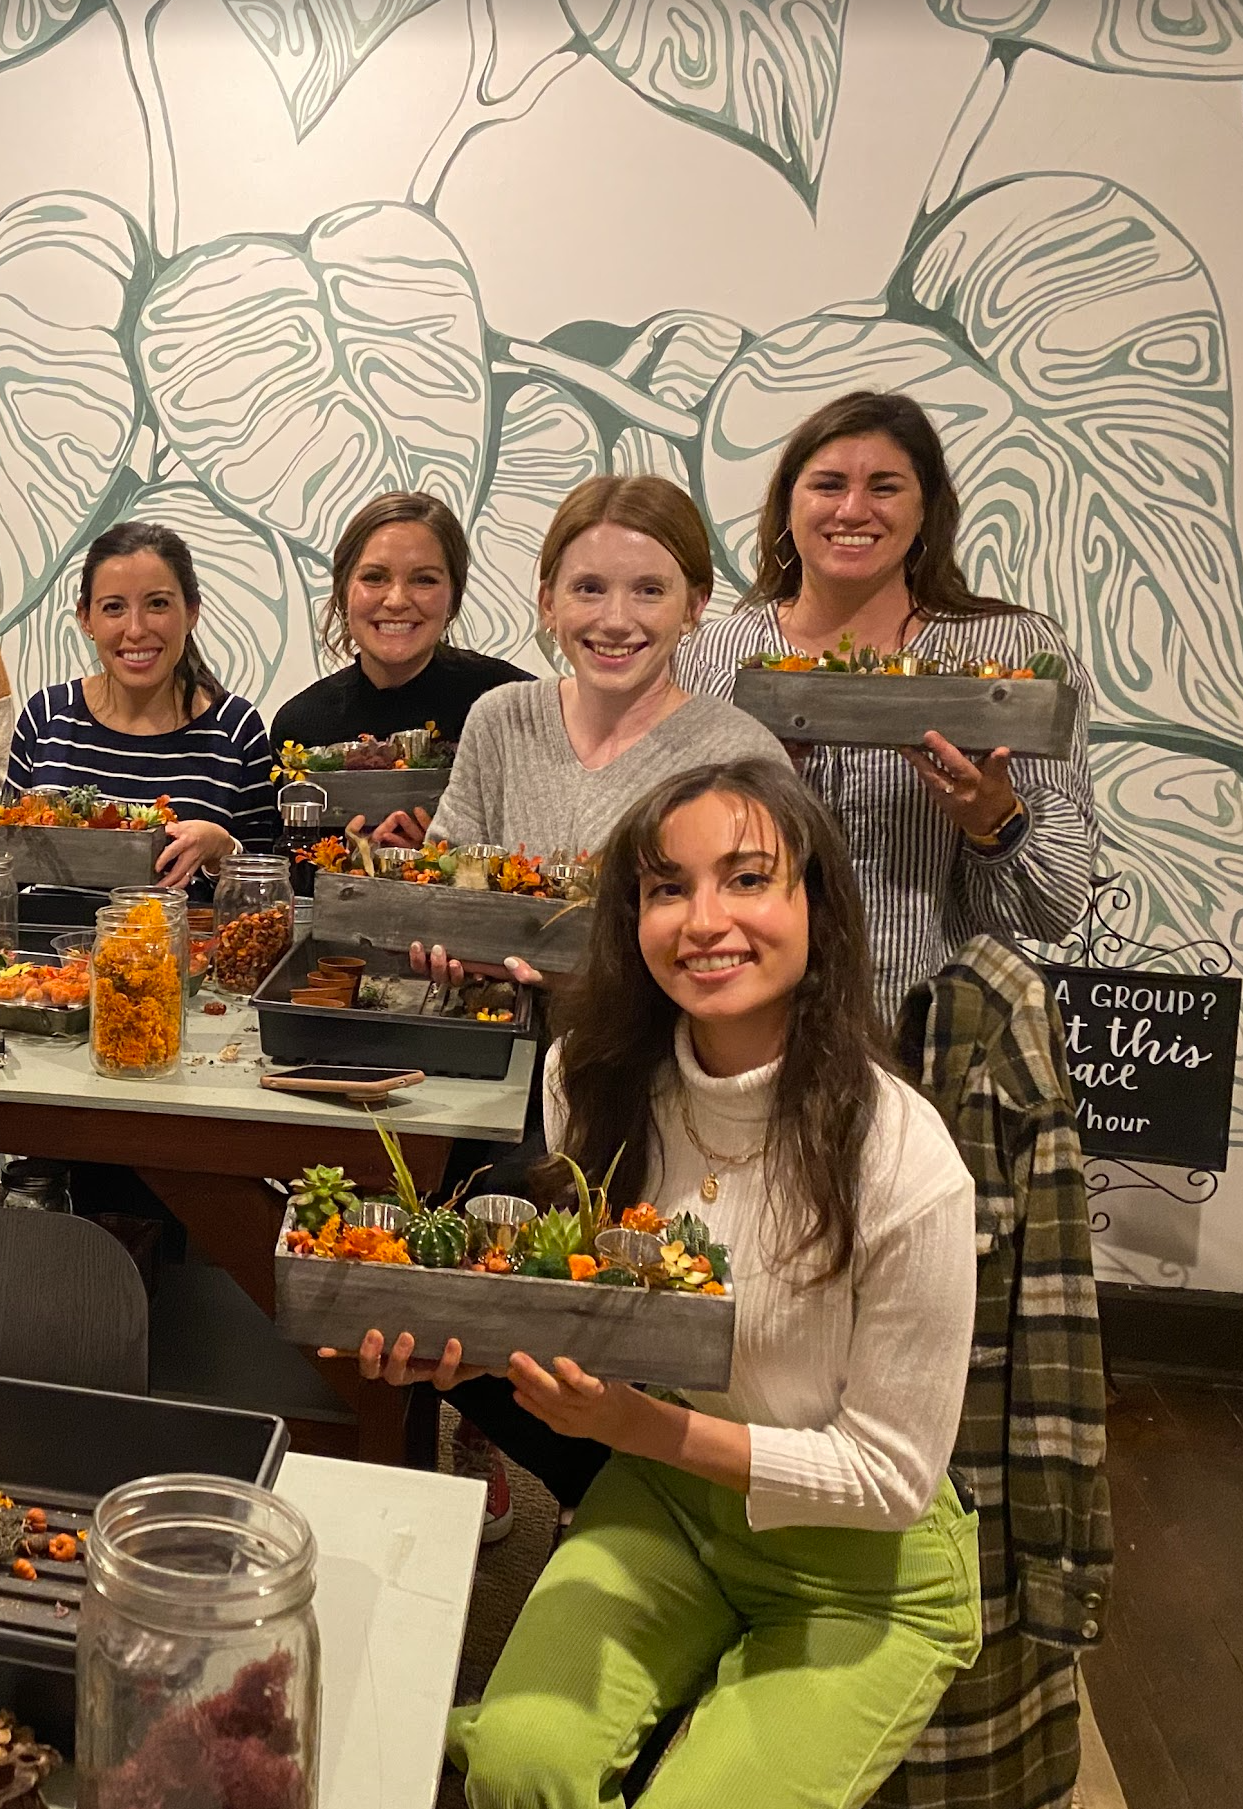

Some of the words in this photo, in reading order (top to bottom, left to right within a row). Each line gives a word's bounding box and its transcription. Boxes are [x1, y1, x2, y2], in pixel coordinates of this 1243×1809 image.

[1054, 979, 1071, 1006] A
[1090, 983, 1217, 1021] GROUP?
[1065, 1014, 1093, 1054] t
[1105, 1016, 1213, 1069] this
[1066, 1062, 1139, 1091] ace
[1074, 1098, 1151, 1133] /hour
